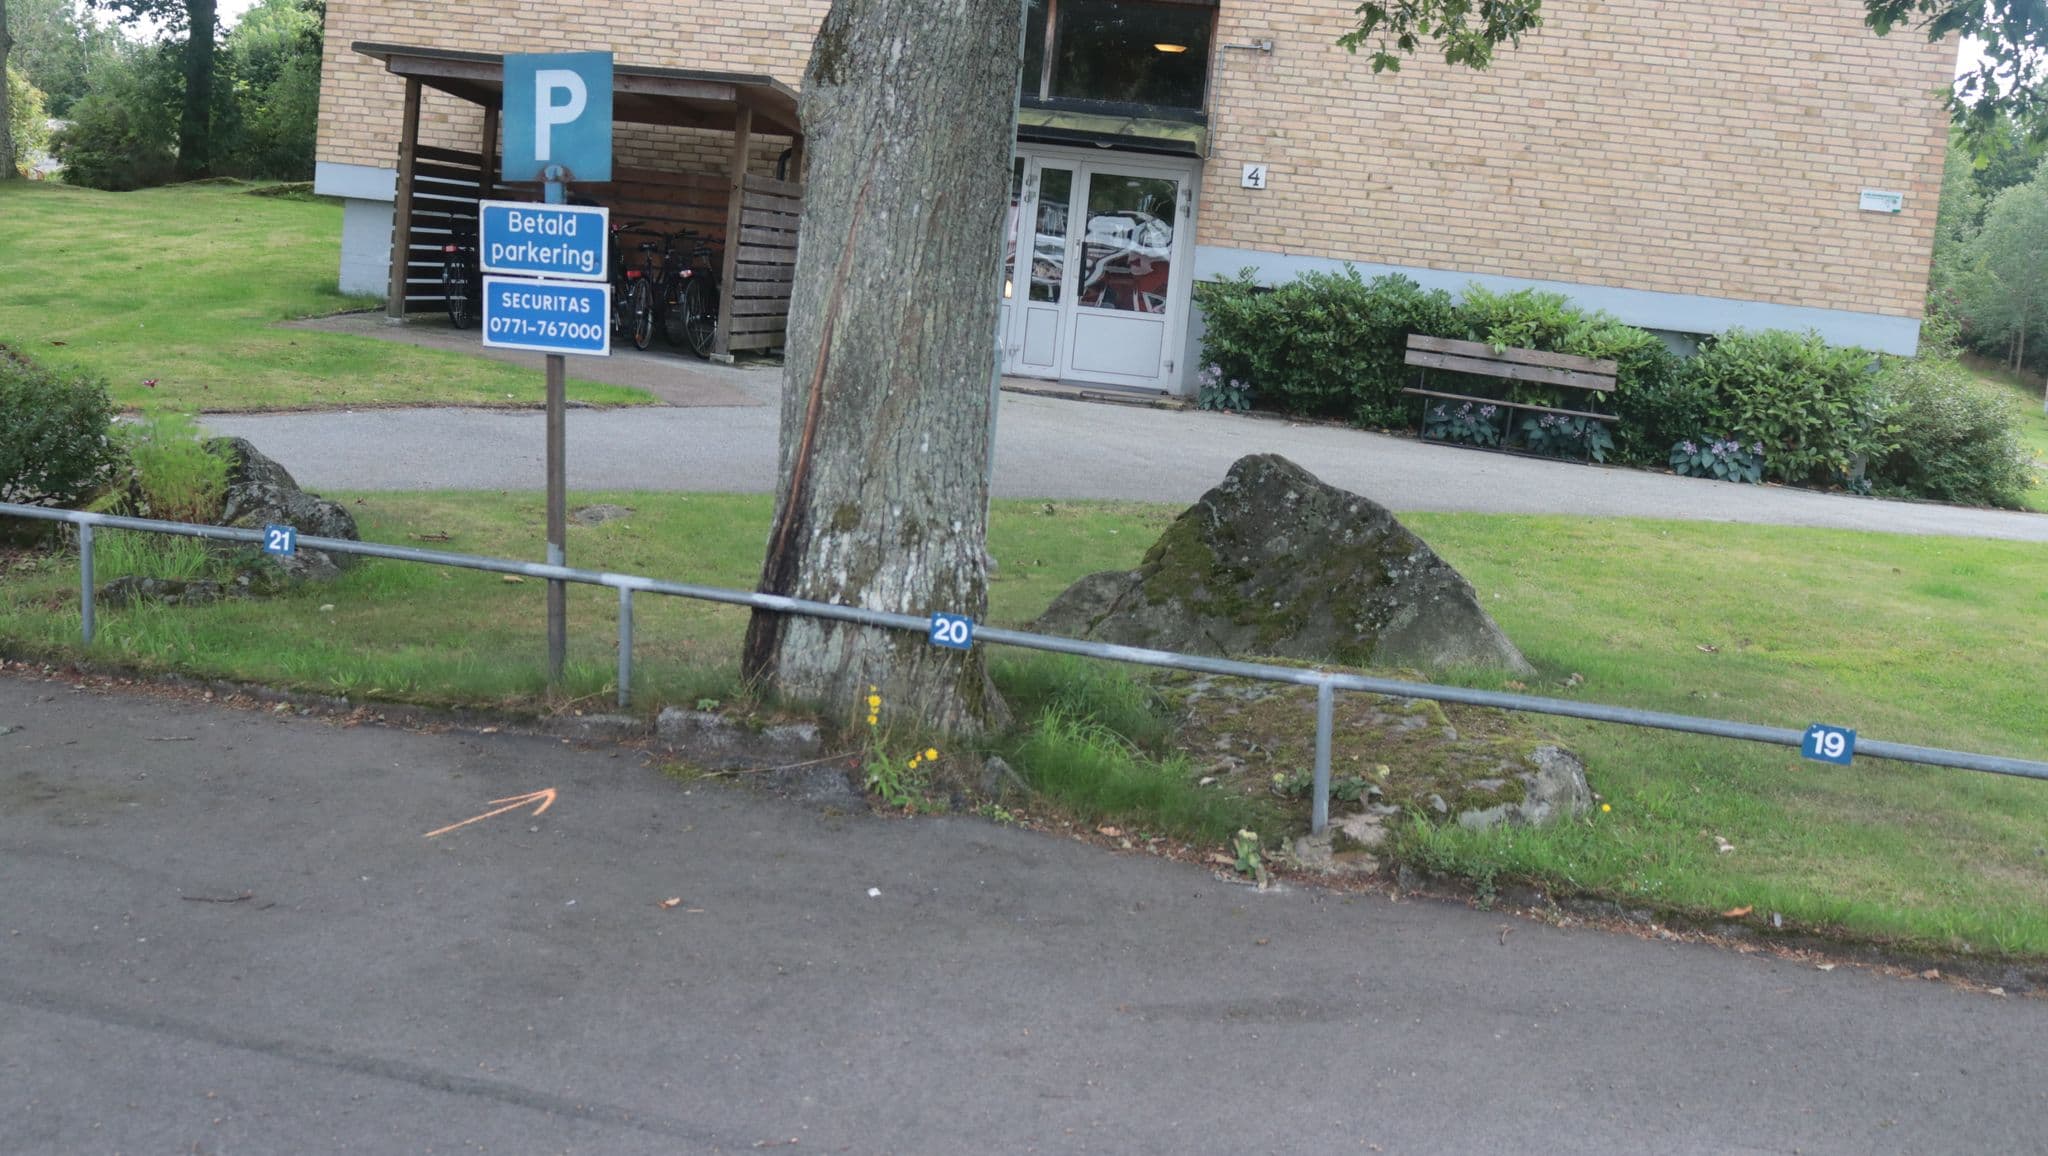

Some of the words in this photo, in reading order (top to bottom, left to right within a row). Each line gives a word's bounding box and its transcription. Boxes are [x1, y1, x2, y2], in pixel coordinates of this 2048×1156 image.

[535, 69, 587, 161] P
[1247, 167, 1260, 186] 4
[508, 211, 577, 237] Betald
[491, 240, 595, 272] parkering
[502, 292, 590, 313] SECURITAS
[490, 317, 602, 340] 0771-767000
[269, 529, 290, 551] 21
[933, 617, 968, 644] 20
[1811, 730, 1846, 758] 19
